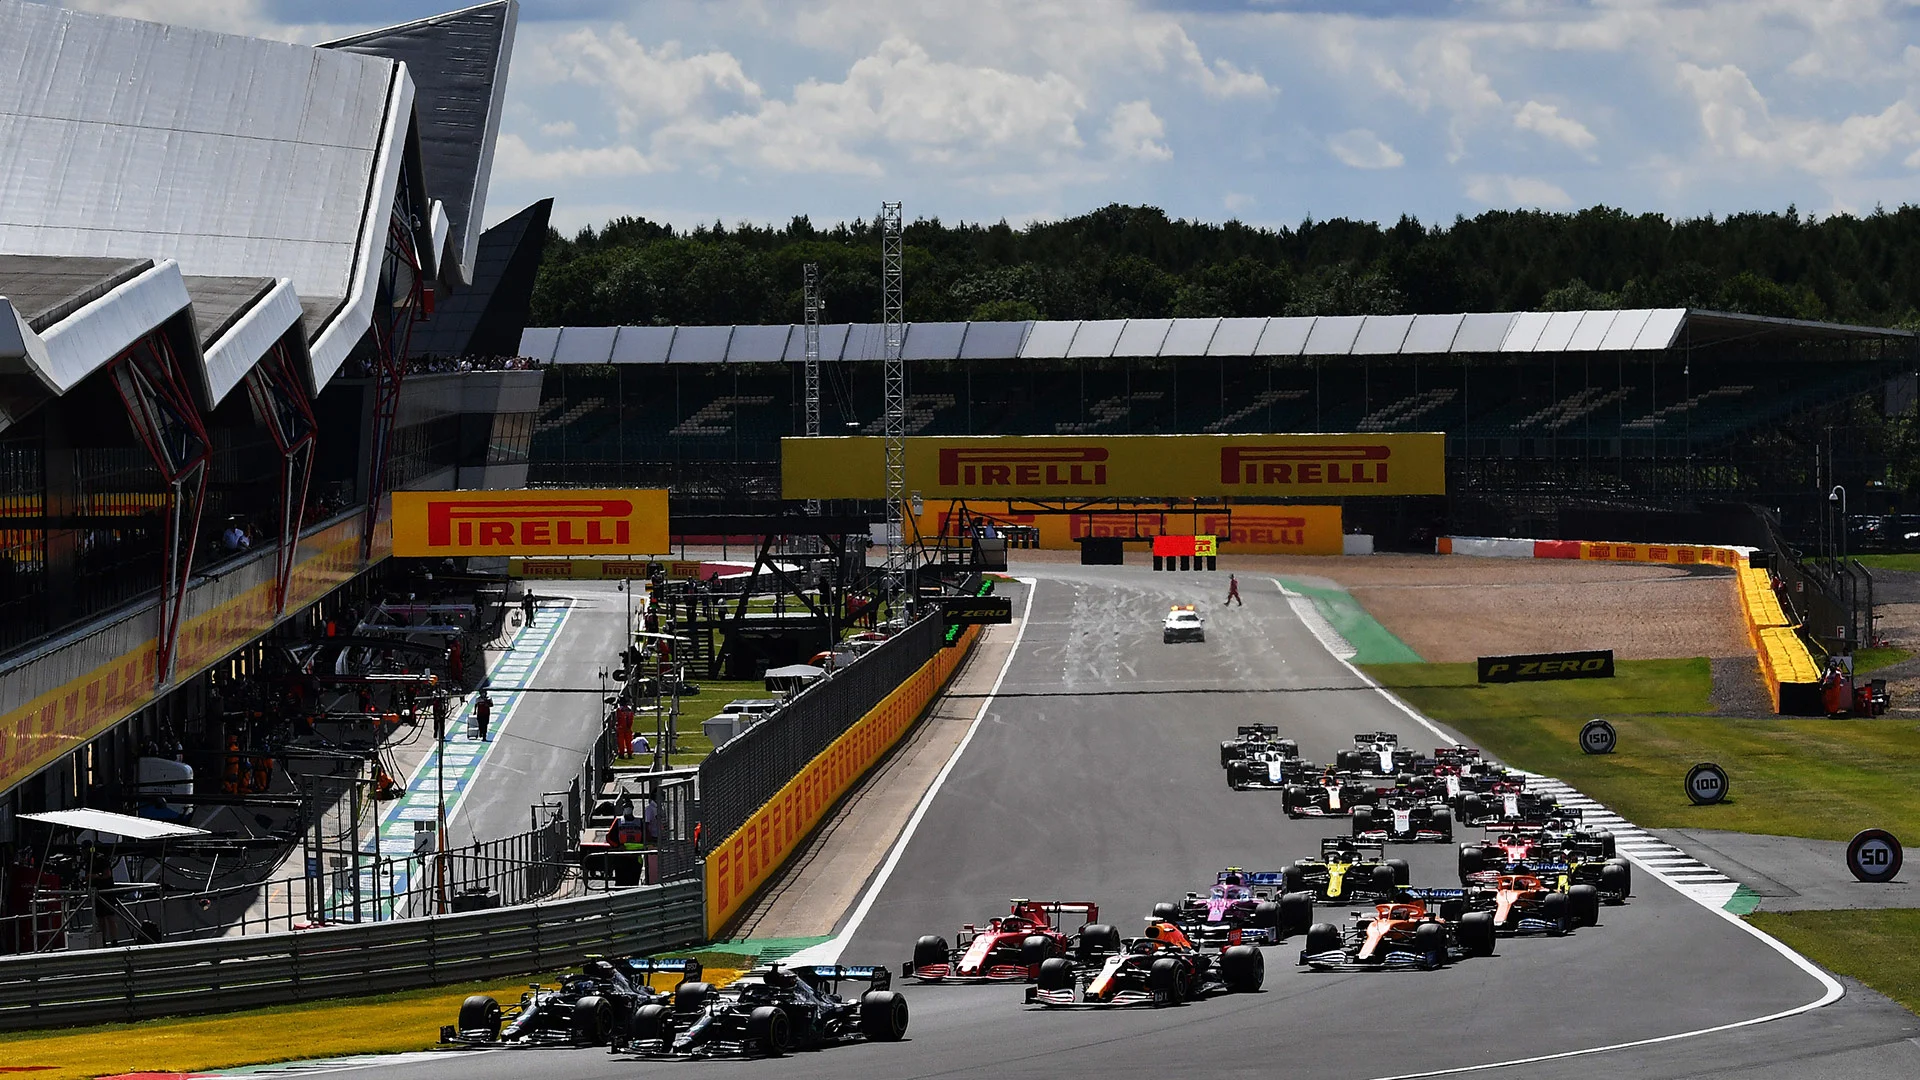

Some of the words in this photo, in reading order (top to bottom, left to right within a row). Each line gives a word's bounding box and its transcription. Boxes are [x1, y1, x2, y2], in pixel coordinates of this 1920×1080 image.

[939, 447, 1109, 485] PIRELLI
[1221, 445, 1391, 484] PIRELLI
[428, 500, 633, 546] PIRELLI
[523, 562, 572, 575] PIRELLI
[961, 609, 1008, 617] ZERO
[1487, 664, 1510, 677] P
[1516, 658, 1606, 676] ZERO
[1589, 733, 1608, 744] 150
[1696, 778, 1718, 790] 100
[1862, 849, 1887, 865] 50
